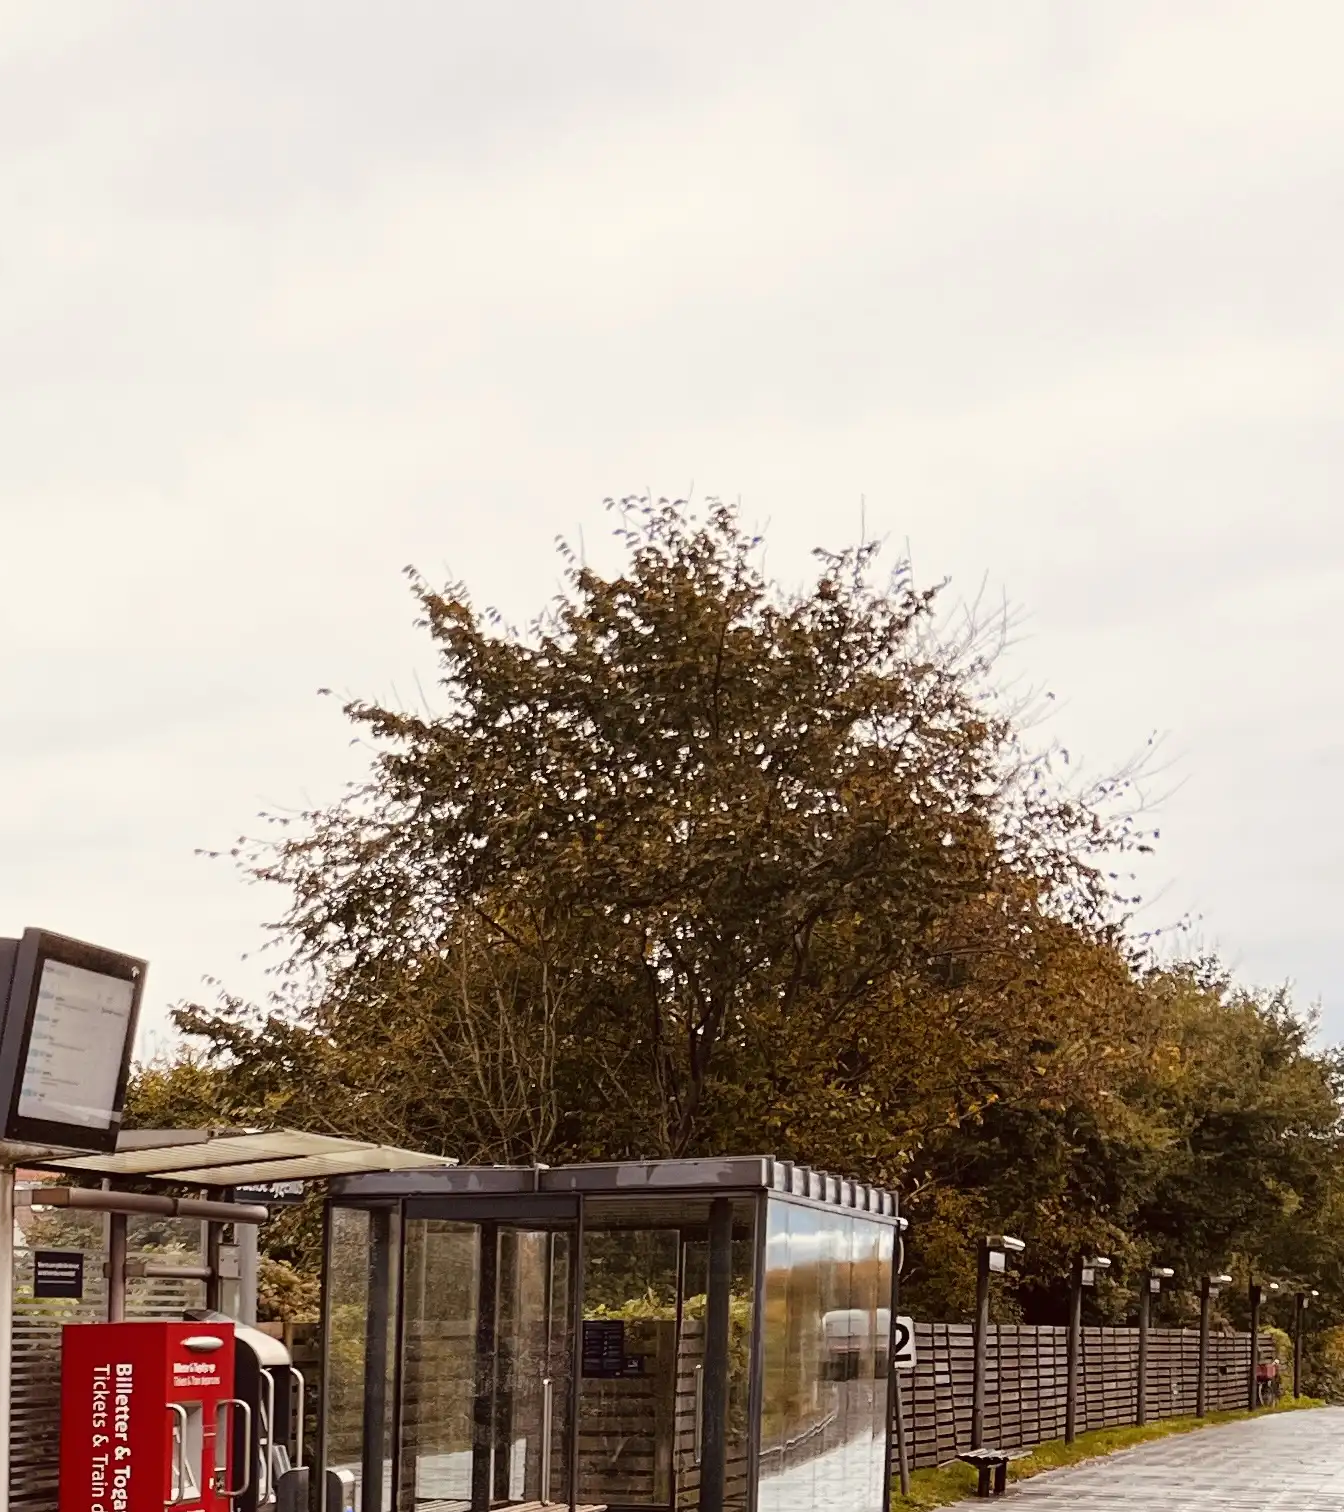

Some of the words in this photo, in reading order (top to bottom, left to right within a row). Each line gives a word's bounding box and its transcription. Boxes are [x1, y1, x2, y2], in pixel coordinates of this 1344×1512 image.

[93, 1363, 110, 1428] Tickets
[115, 1363, 133, 1441] Billetter
[92, 1434, 109, 1447] &
[114, 1446, 131, 1460] &
[92, 1453, 109, 1497] Train
